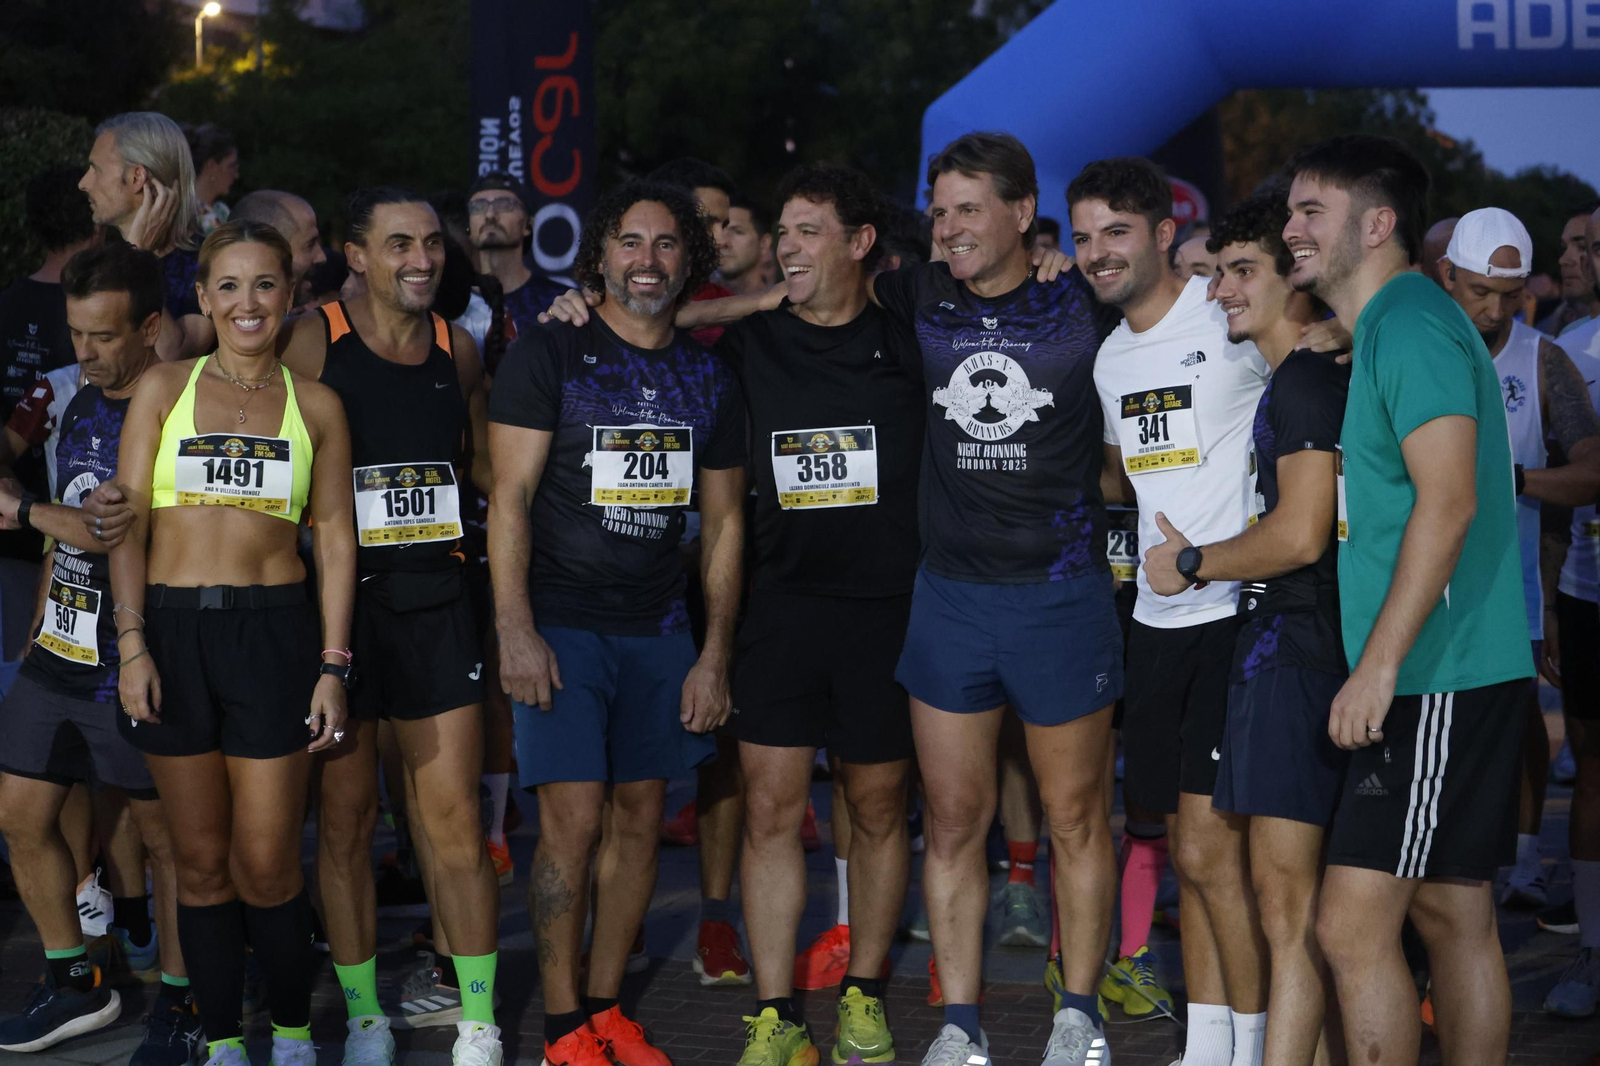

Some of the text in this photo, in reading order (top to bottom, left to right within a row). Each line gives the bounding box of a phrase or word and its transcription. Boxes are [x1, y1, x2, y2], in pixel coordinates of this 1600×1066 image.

[952, 338, 980, 351] Welcome
[1138, 412, 1170, 445] 341
[254, 444, 270, 452] ROCK
[957, 442, 1027, 459] NIGHT RUNNING
[202, 458, 264, 488] 1491
[623, 452, 669, 480] 204
[796, 453, 848, 483] 358
[1002, 459, 1027, 471] 2025
[220, 487, 241, 495] VILLEGAS
[380, 487, 436, 518] 1501
[603, 505, 670, 529] NIGHT RUNNING
[645, 528, 665, 539] 2025
[55, 603, 78, 636] 597
[1355, 787, 1389, 796] adidas
